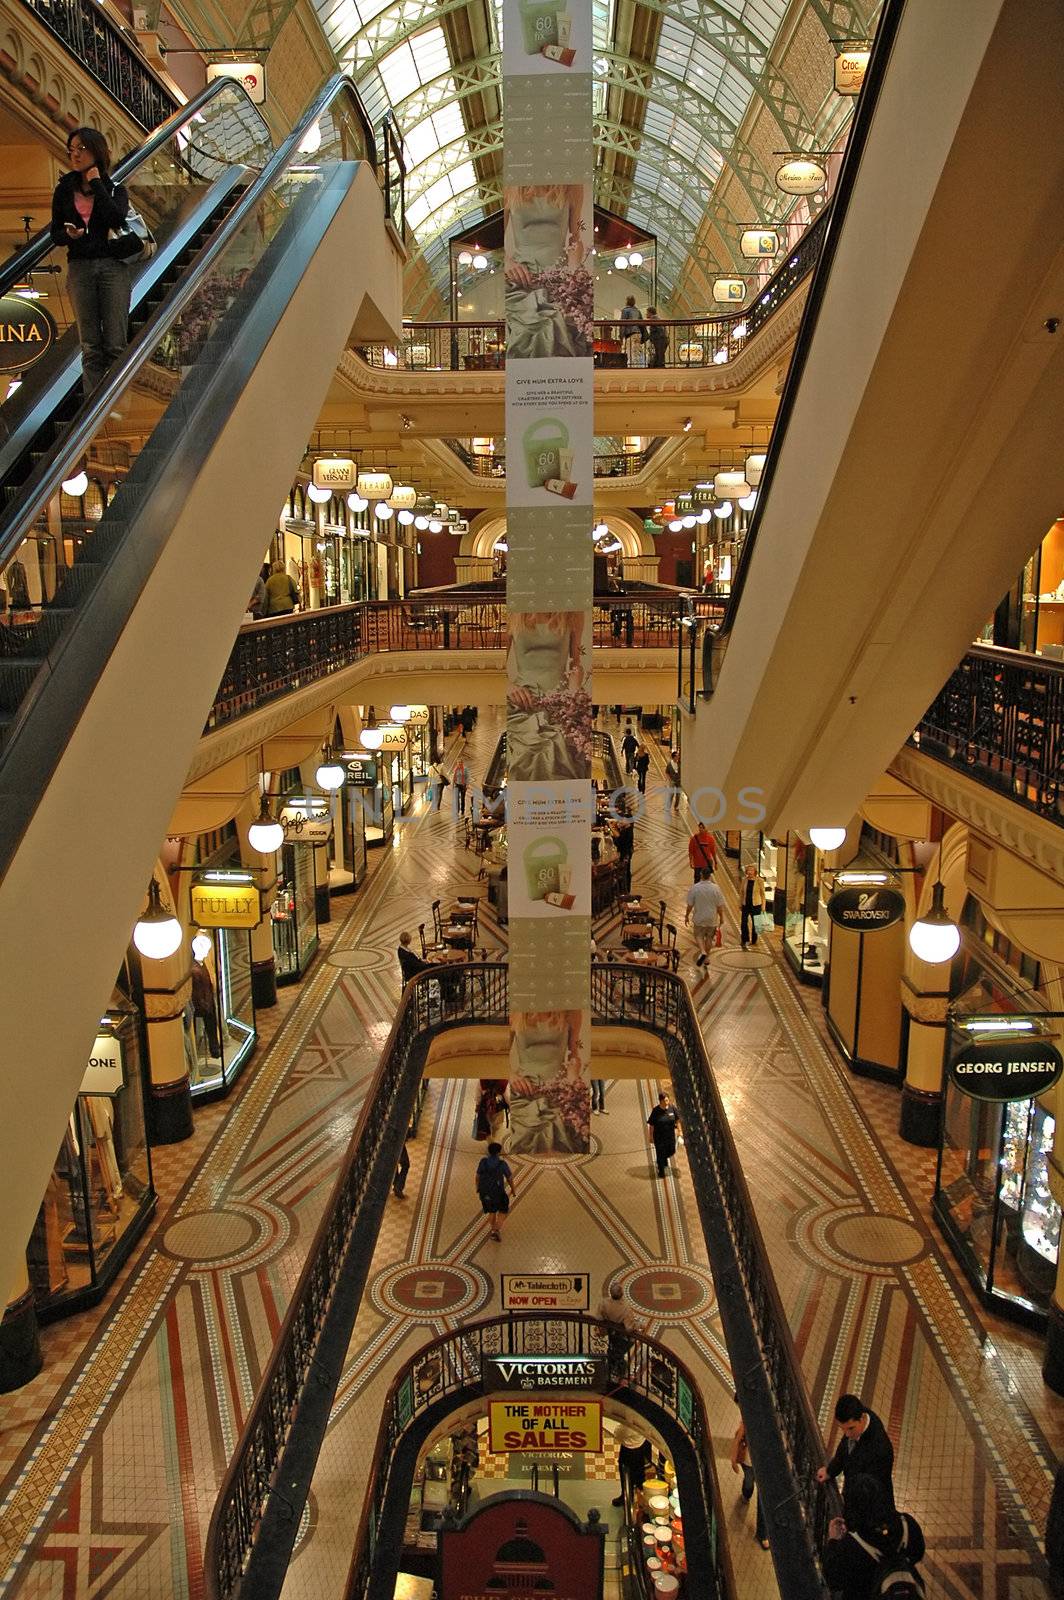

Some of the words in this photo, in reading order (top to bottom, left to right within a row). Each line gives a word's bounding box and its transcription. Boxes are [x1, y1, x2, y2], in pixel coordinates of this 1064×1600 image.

[0, 323, 43, 343] INA
[539, 451, 555, 466] 60
[694, 490, 717, 501] FÉRAU
[410, 710, 428, 719] DAS
[382, 734, 406, 744] IDAS
[539, 866, 555, 881] 60
[194, 897, 257, 914] TULLY
[843, 910, 890, 920] SWAROVSKI
[956, 1062, 1003, 1074] GEORG
[1006, 1062, 1056, 1076] JENSEN
[509, 1296, 529, 1306] NOW
[532, 1296, 557, 1306] OPEN
[496, 1362, 596, 1383] VICTORIA'S
[538, 1377, 593, 1385] BASEMENT
[504, 1405, 529, 1417] THE
[533, 1405, 586, 1417] MOTHER
[522, 1419, 539, 1430] OF
[544, 1419, 569, 1430] ALL
[503, 1431, 588, 1449] SALES
